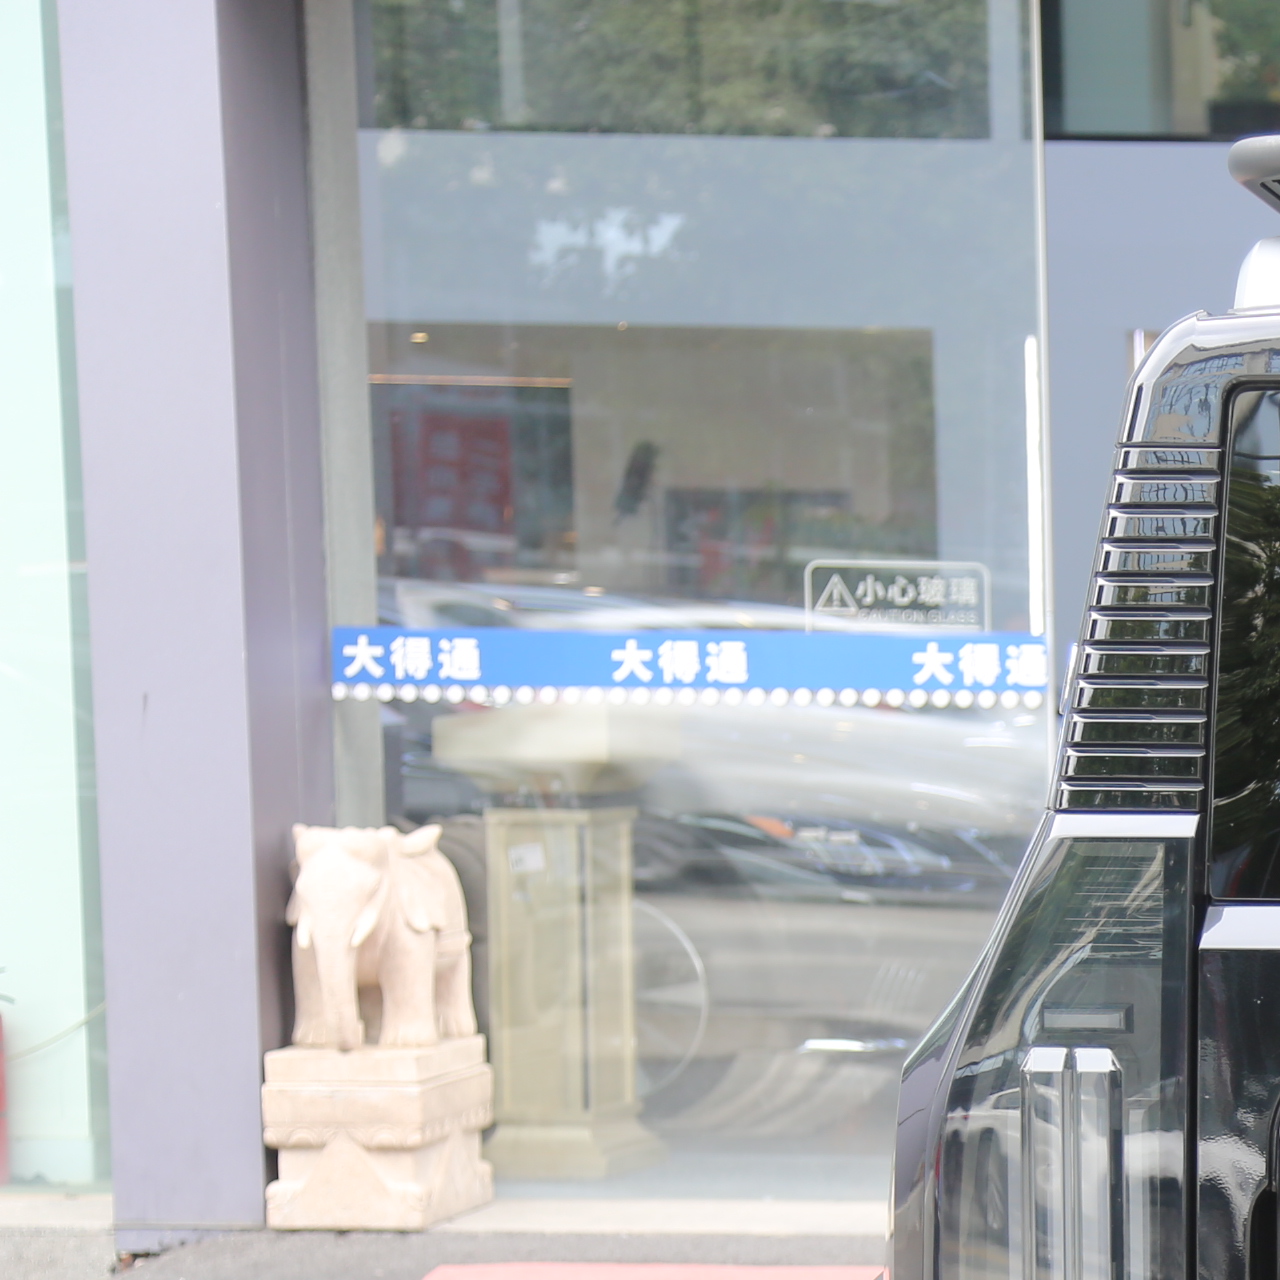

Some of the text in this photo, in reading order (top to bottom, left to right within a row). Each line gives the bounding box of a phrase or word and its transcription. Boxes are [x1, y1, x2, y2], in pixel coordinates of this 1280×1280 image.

[855, 574, 979, 606] 小心玻璃
[342, 634, 482, 681] 大得通
[610, 638, 749, 684] 大得通
[911, 641, 1048, 687] 大得通
